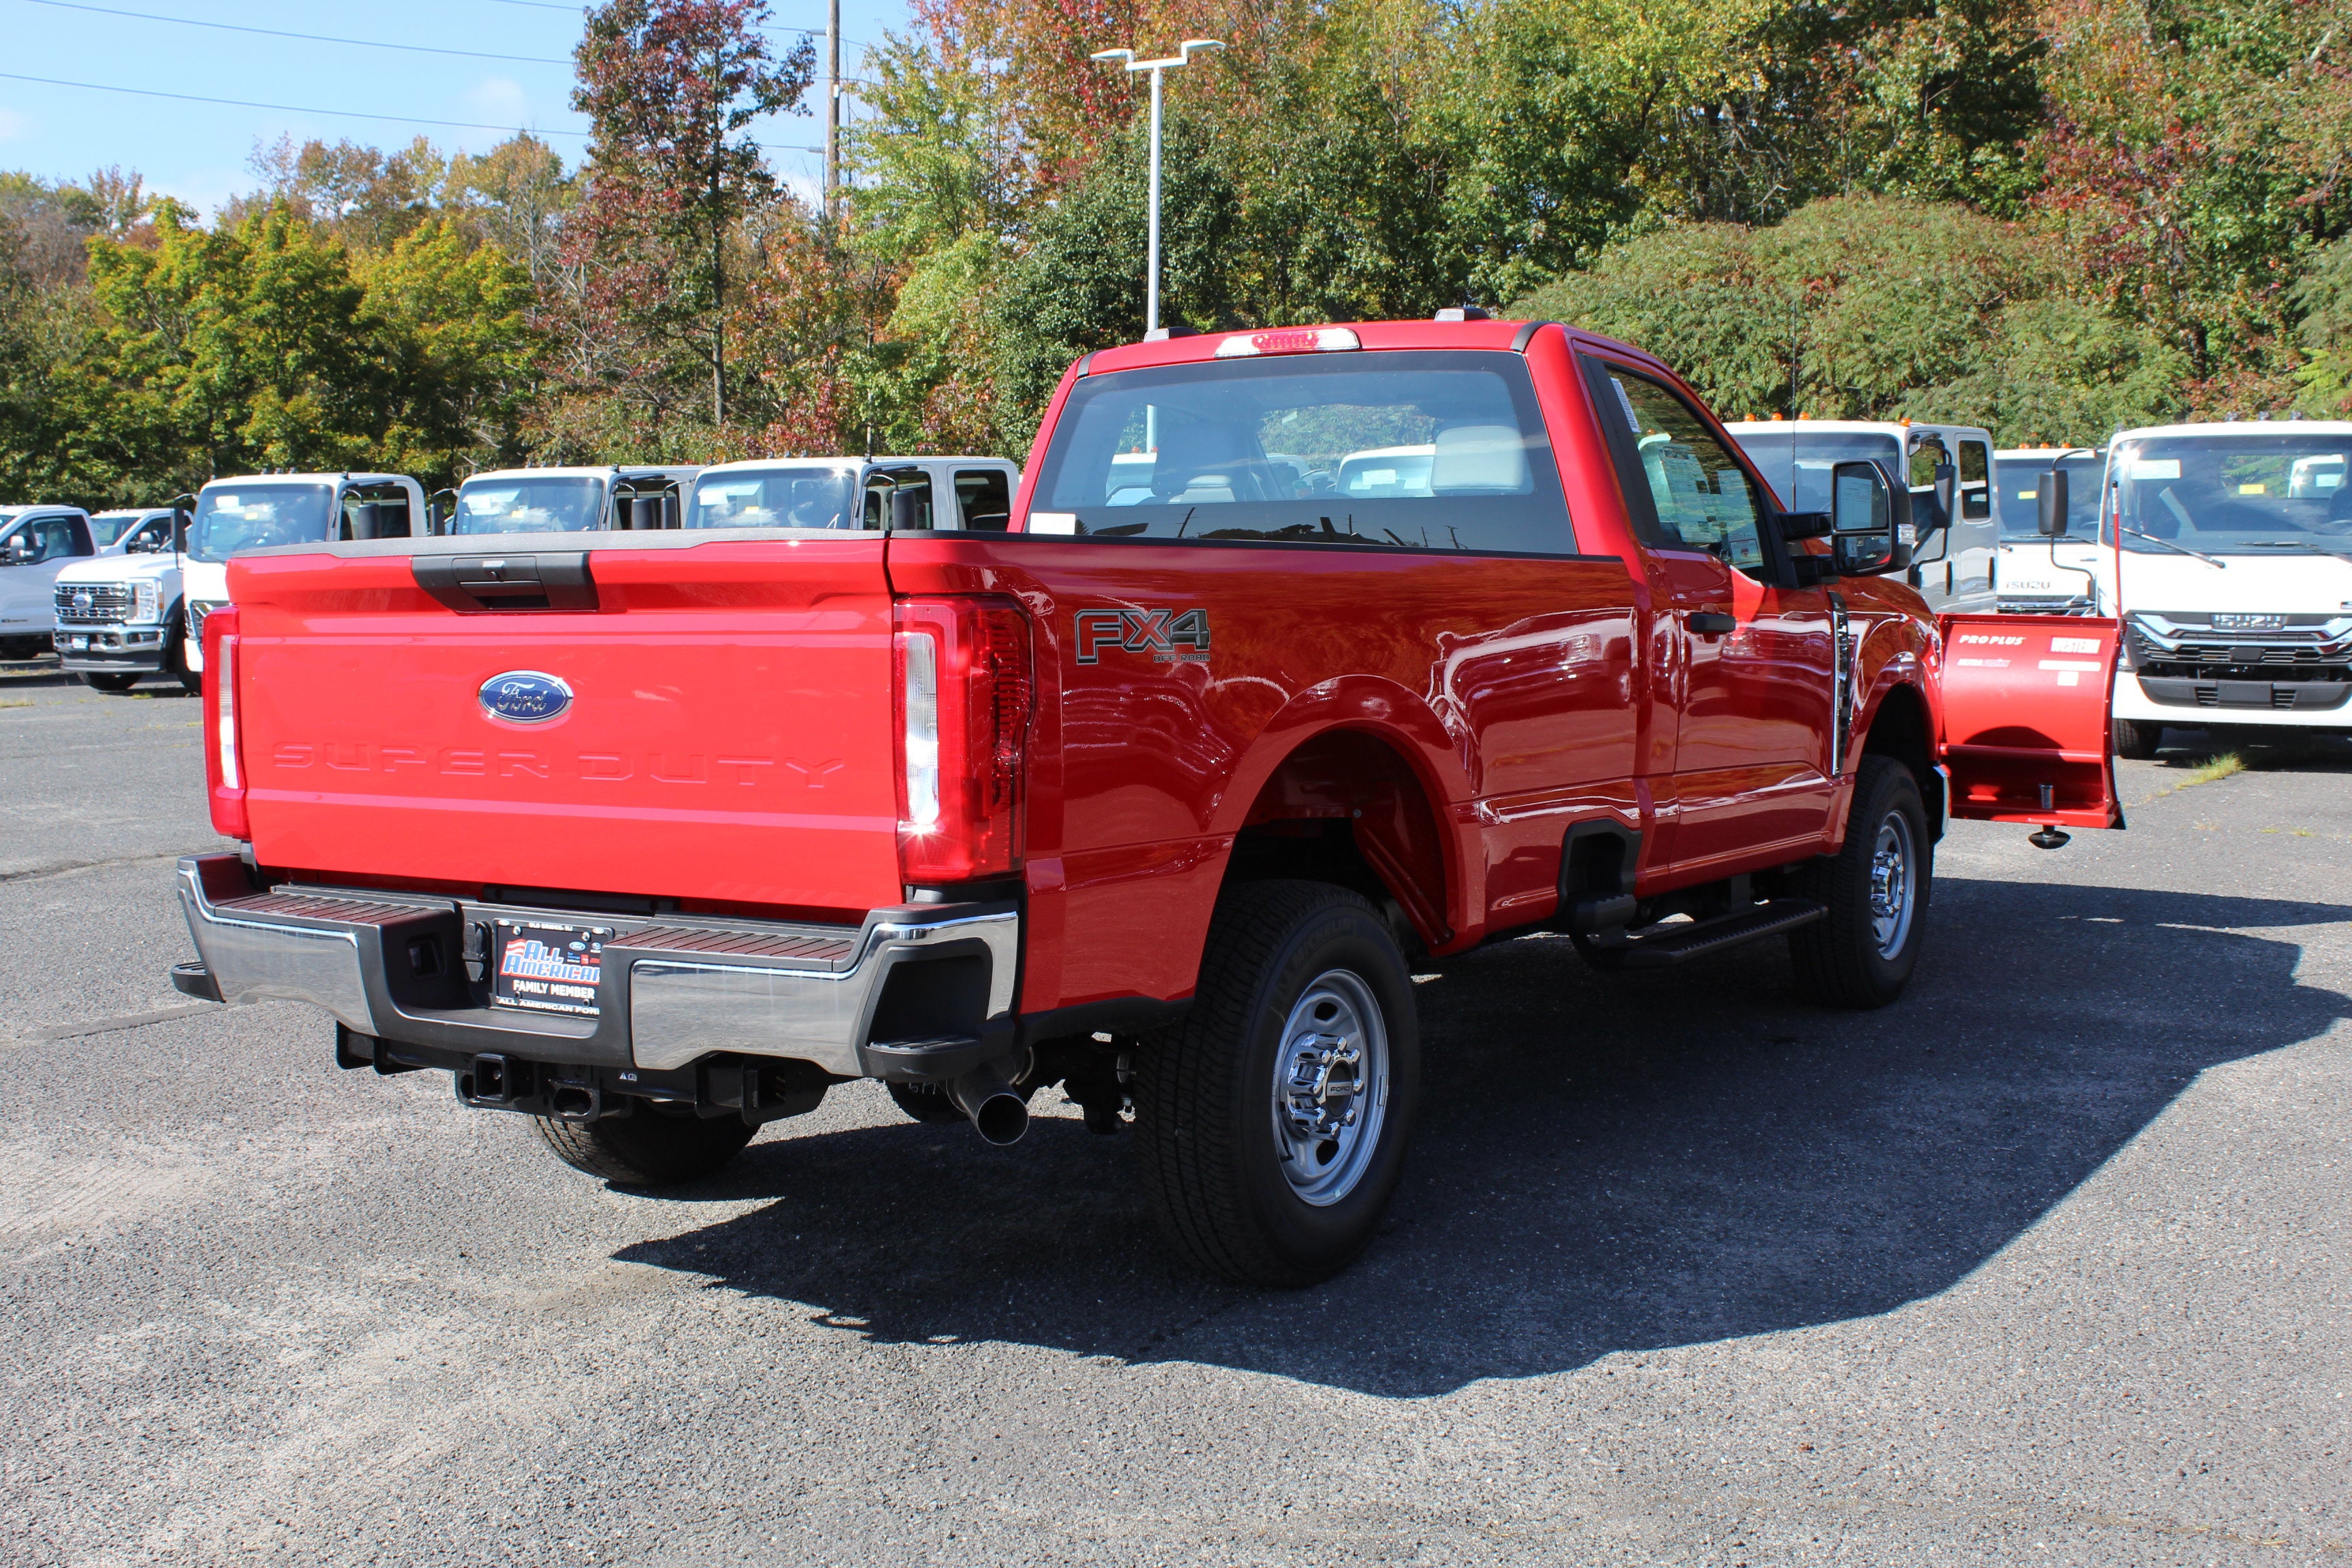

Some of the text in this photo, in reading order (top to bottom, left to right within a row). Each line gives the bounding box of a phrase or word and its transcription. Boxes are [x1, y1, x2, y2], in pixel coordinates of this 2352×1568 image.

[2006, 581, 2050, 589] ISUZU
[2214, 614, 2281, 628] ISUZU
[1074, 608, 1211, 666] FX4
[1959, 634, 2024, 646] PRO PLUS
[1153, 653, 1211, 663] OFF ROAD
[497, 681, 549, 713] Ford
[272, 740, 845, 789] SUPER DUTY
[523, 940, 564, 964] ALL
[512, 980, 595, 1000] FAMILY MEMBER
[519, 1000, 574, 1012] AMERICAN
